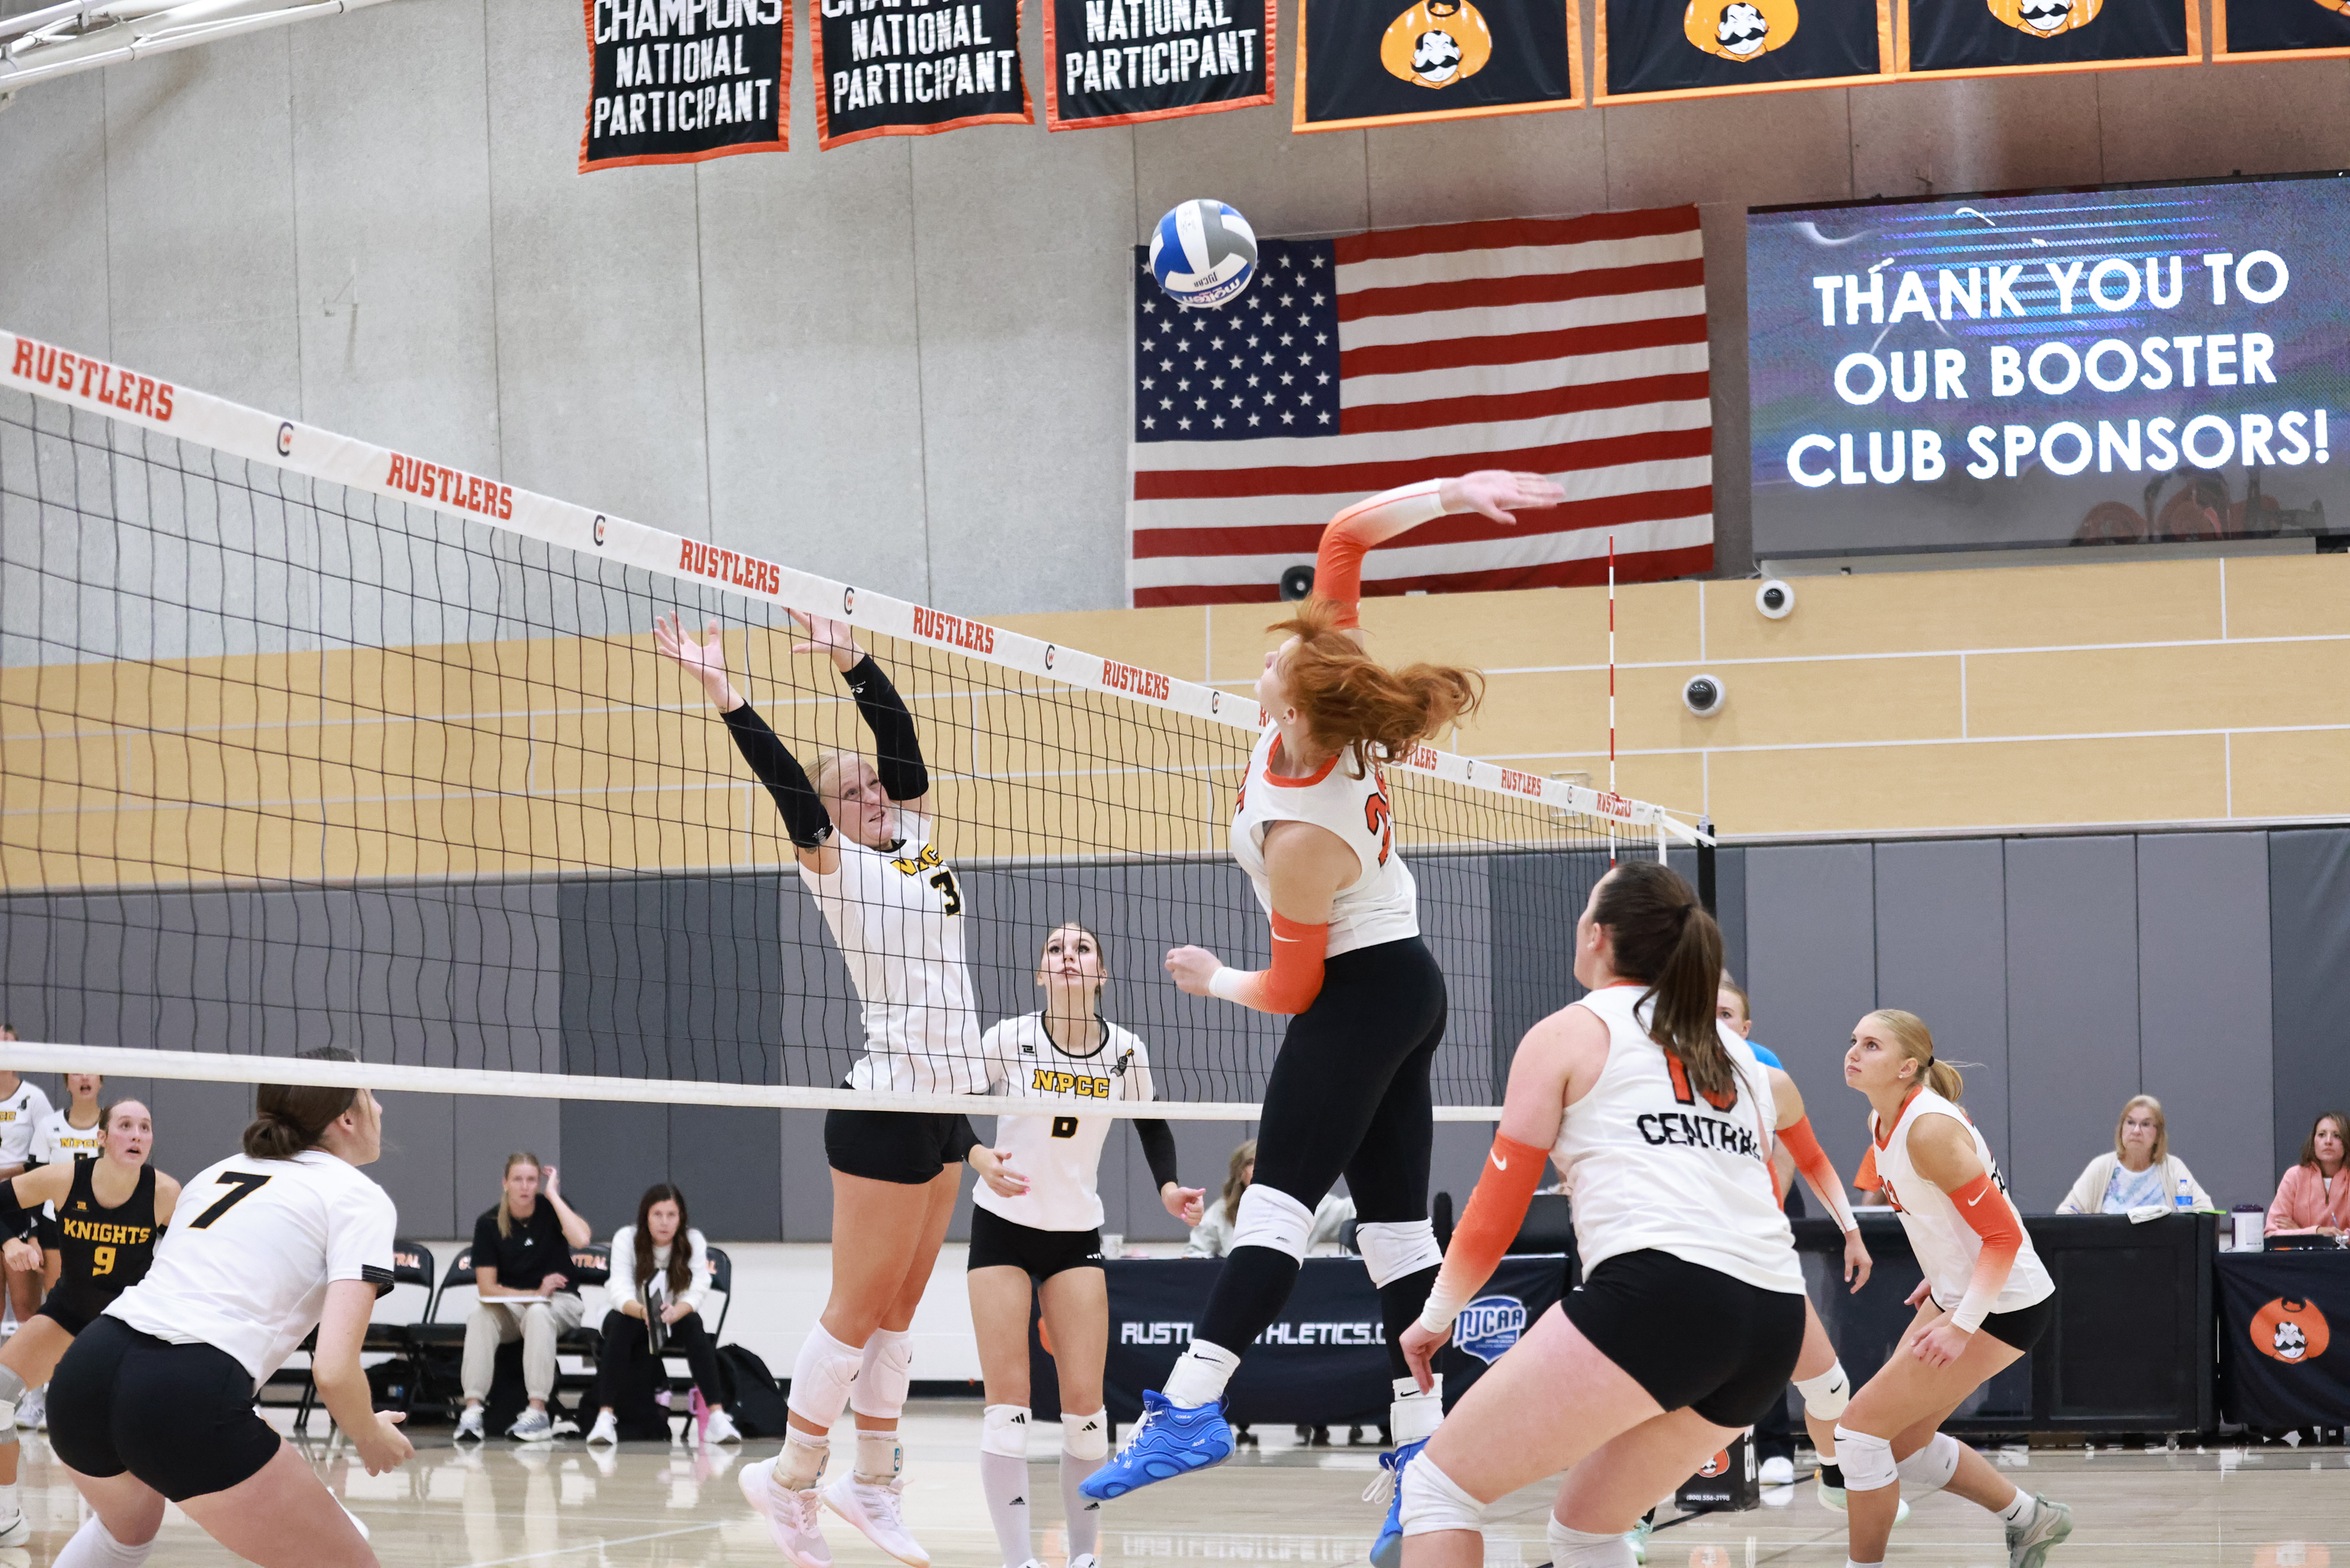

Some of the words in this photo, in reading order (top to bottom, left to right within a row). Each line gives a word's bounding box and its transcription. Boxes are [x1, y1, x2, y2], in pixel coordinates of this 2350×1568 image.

[851, 5, 992, 62] NATIONAL
[1085, 0, 1232, 43] NATIONAL
[616, 34, 750, 89] NATIONAL
[833, 50, 1015, 114] PARTICIPANT
[1065, 28, 1257, 96] PARTICIPANT
[593, 78, 772, 139] PARTICIPANT
[1813, 264, 2026, 327] THANK
[2046, 255, 2184, 315] YOU
[2204, 250, 2290, 306] TO
[12, 337, 174, 422] RUSTLERS
[1834, 348, 1969, 406] OUR
[1990, 332, 2277, 398] BOOSTER
[1787, 429, 1946, 488] CLUB
[1966, 409, 2330, 480] SPONSORS!
[386, 451, 513, 520] RUSTLERS
[679, 538, 780, 596] RUSTLERS
[913, 605, 994, 655] RUSTLERS
[1102, 659, 1170, 701] RUSTLERS
[1501, 769, 1542, 797] RUSTLERS
[930, 870, 960, 917] 3
[1032, 1069, 1110, 1098] NPCC
[188, 1171, 272, 1229] 7
[63, 1217, 151, 1245] KNIGHTS
[92, 1246, 117, 1276] 9
[1456, 1308, 1524, 1343] NJCAA
